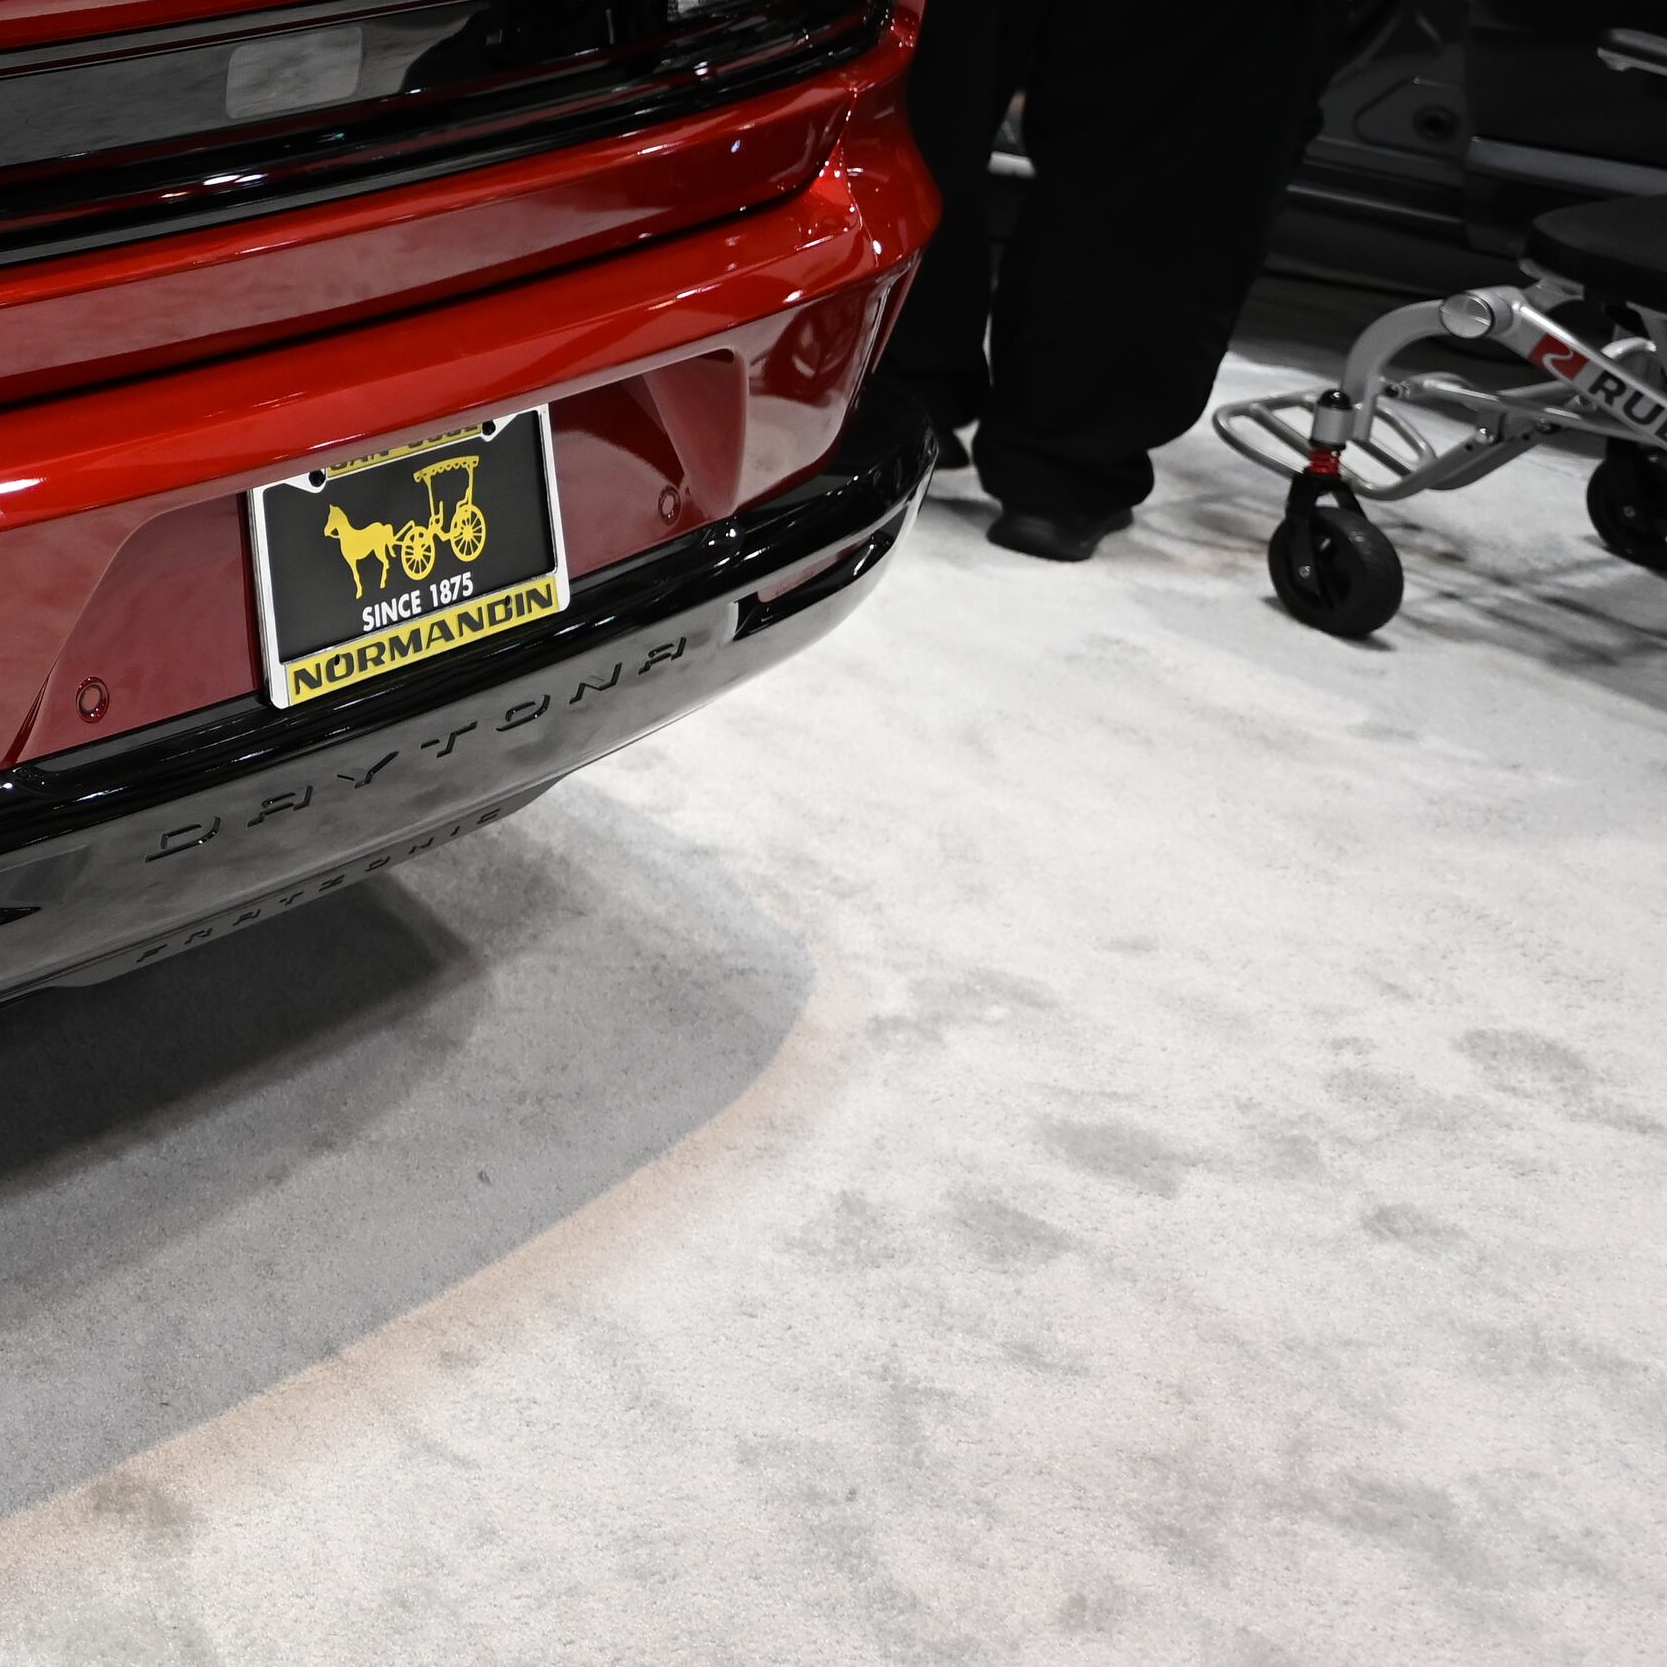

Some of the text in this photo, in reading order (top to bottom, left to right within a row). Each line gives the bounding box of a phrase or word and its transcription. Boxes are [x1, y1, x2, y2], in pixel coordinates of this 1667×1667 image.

[293, 584, 554, 695] NORMANDIN
[362, 571, 474, 631] SINCE 1875
[144, 636, 687, 862] DAYTONA
